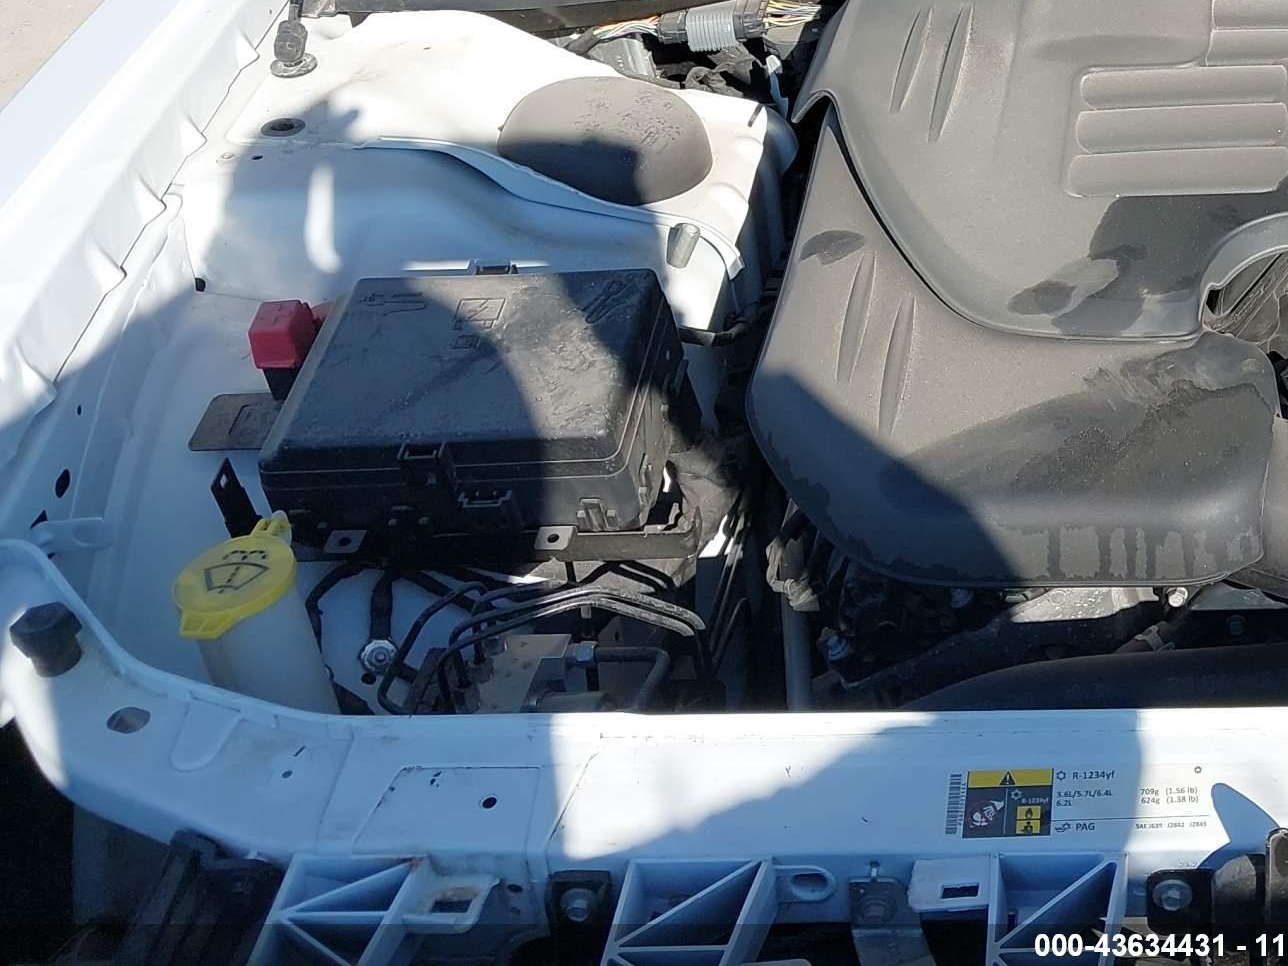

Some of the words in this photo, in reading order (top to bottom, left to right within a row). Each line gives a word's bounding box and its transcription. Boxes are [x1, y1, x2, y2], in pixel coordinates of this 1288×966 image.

[1072, 769, 1115, 780] R-1234yf
[1140, 788, 1160, 796] 709g
[1165, 786, 1186, 795] (1.56
[1187, 786, 1198, 794] lb)
[1141, 797, 1160, 805] 624g
[1166, 795, 1186, 804] (1.38
[1188, 795, 1199, 803] lb)
[1075, 822, 1096, 832] PAG
